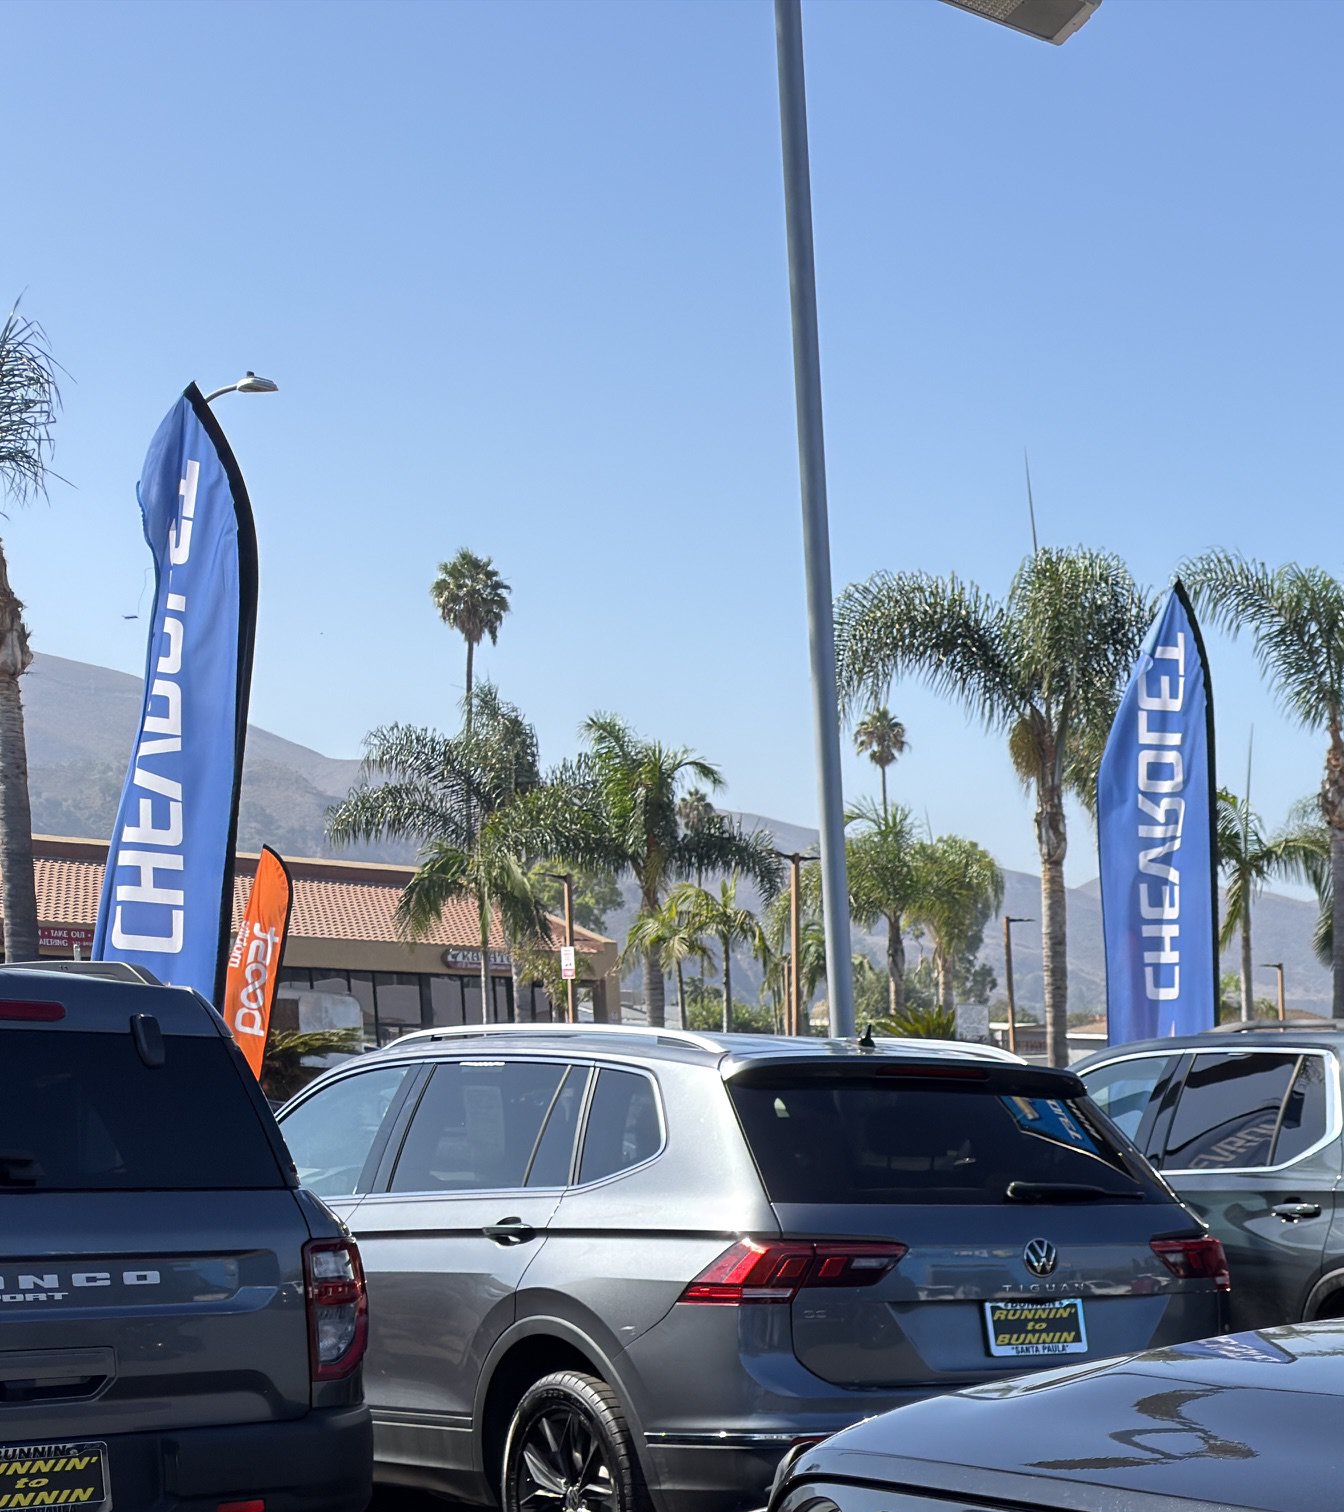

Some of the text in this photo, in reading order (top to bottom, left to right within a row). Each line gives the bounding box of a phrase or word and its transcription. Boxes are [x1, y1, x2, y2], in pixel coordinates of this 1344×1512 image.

[0, 1270, 160, 1290] NCO
[1002, 1283, 1084, 1292] TIGUAN
[0, 1292, 69, 1302] ORT
[993, 1307, 1076, 1321] RUNNIN'
[1027, 1321, 1048, 1331] to
[996, 1331, 1076, 1346] BUNNIN
[15, 1477, 49, 1489] to
